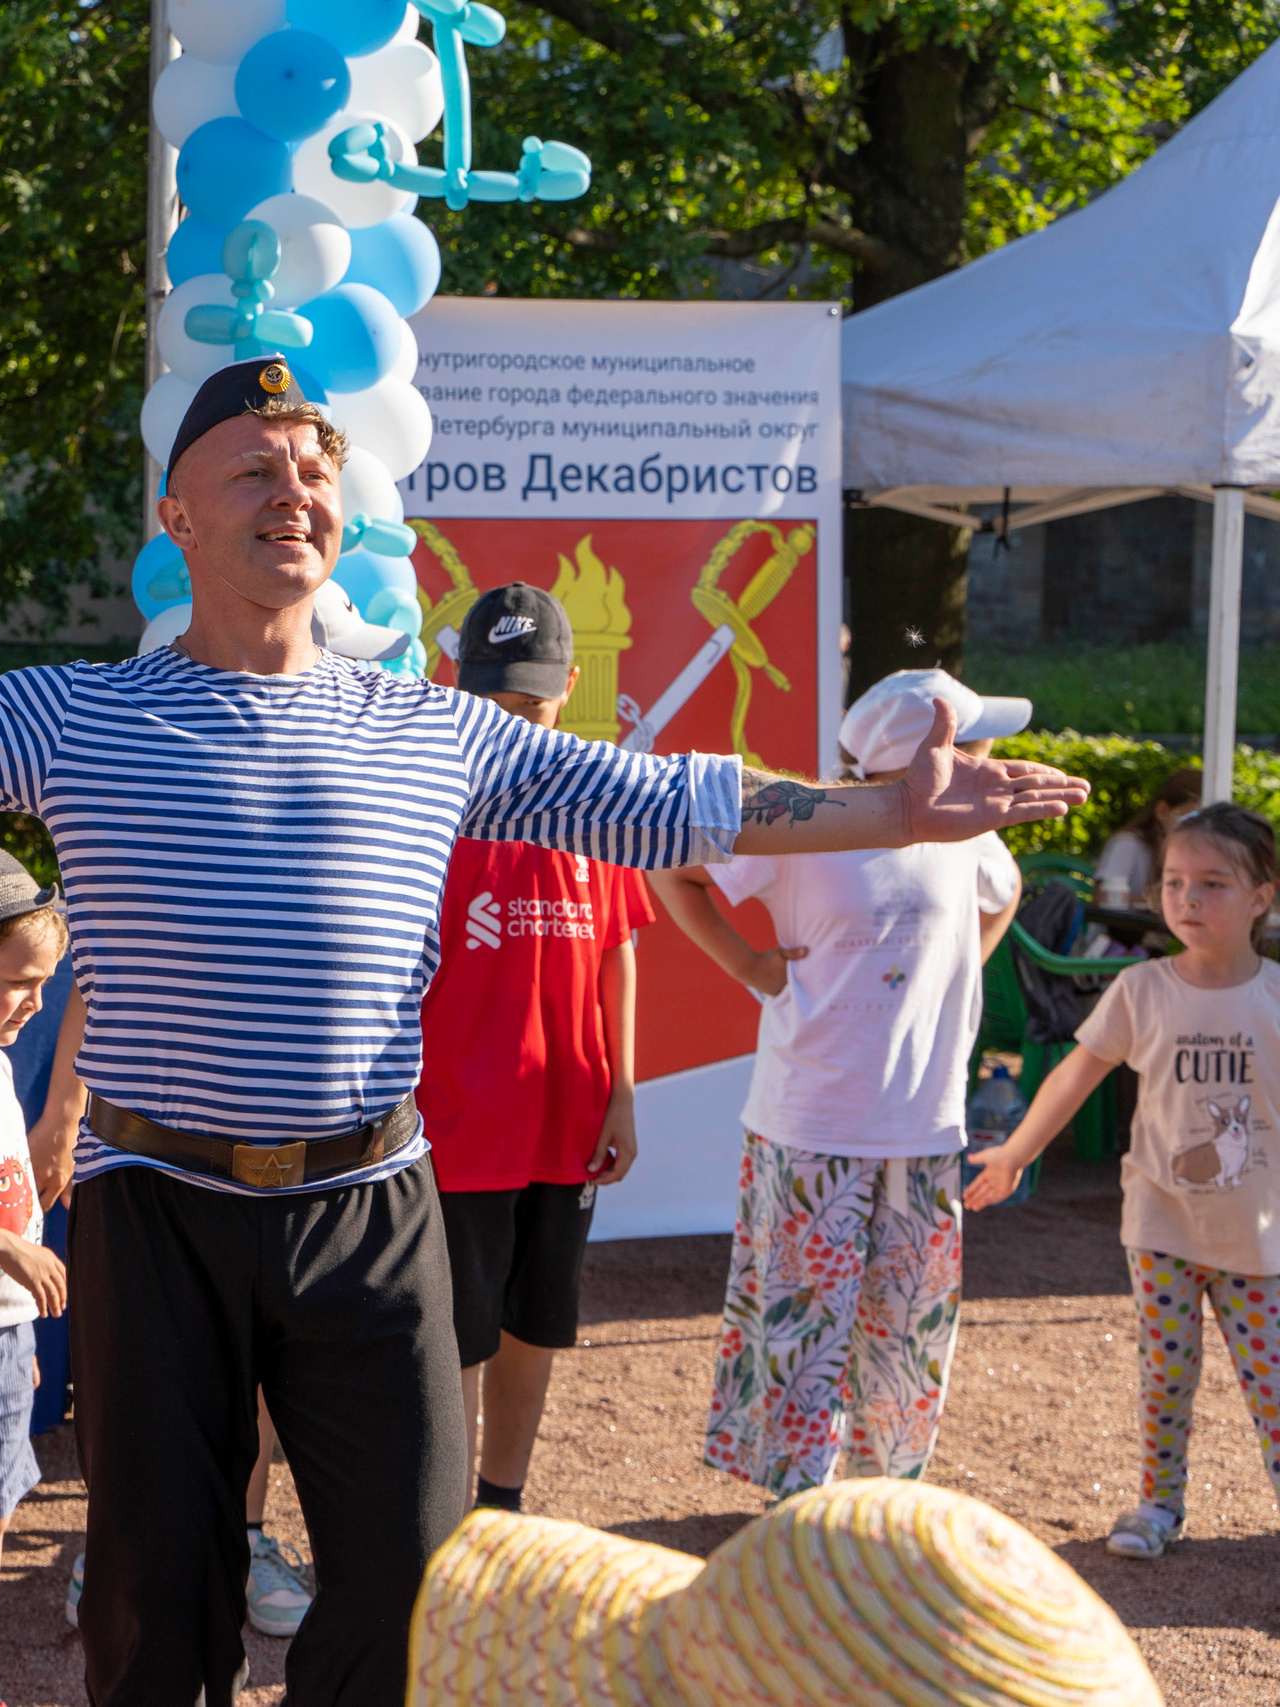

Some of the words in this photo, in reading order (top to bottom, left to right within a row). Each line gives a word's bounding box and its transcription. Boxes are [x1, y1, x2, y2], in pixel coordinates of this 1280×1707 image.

[592, 355, 756, 376] муниципальное
[488, 386, 561, 406] города
[567, 383, 717, 408] федерального
[723, 389, 819, 407] значения
[562, 418, 752, 442] муниципальный
[759, 422, 818, 443] округ
[522, 451, 819, 504] Декабристов
[494, 616, 534, 634] NIKE
[1229, 1031, 1242, 1048] of
[1175, 1049, 1255, 1084] CUTIE
